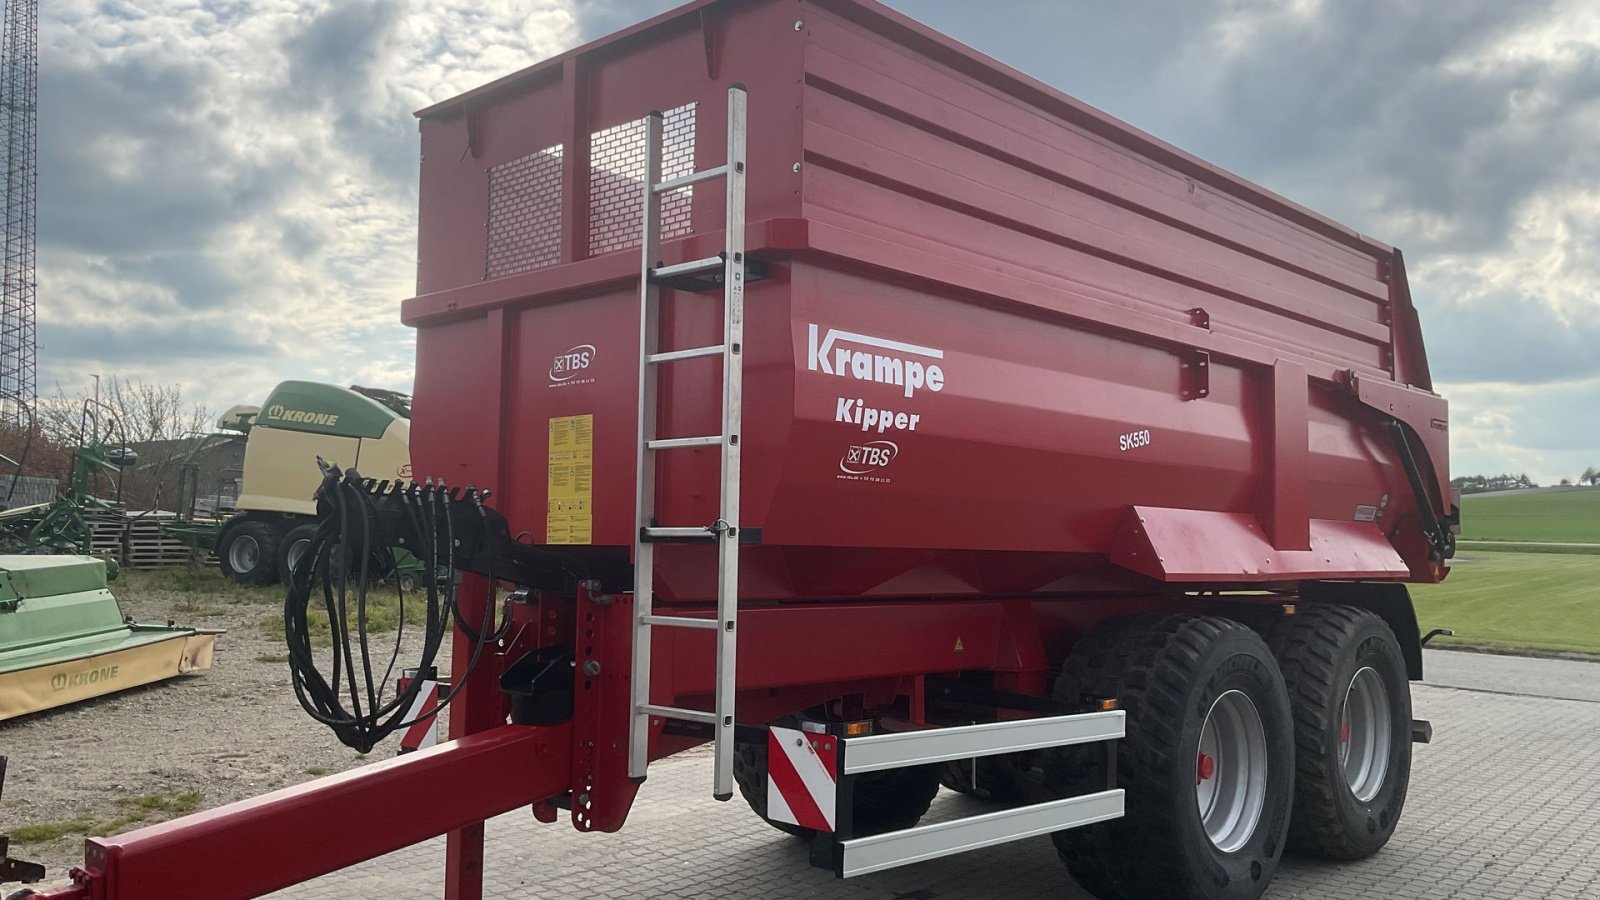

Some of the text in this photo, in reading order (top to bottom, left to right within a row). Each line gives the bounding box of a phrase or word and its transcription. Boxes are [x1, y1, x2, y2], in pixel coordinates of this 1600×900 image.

[808, 323, 944, 397] Krampe
[282, 410, 339, 426] KRONE
[835, 397, 920, 433] Kipper
[1119, 429, 1150, 451] SK550
[67, 665, 119, 689] KRONE
